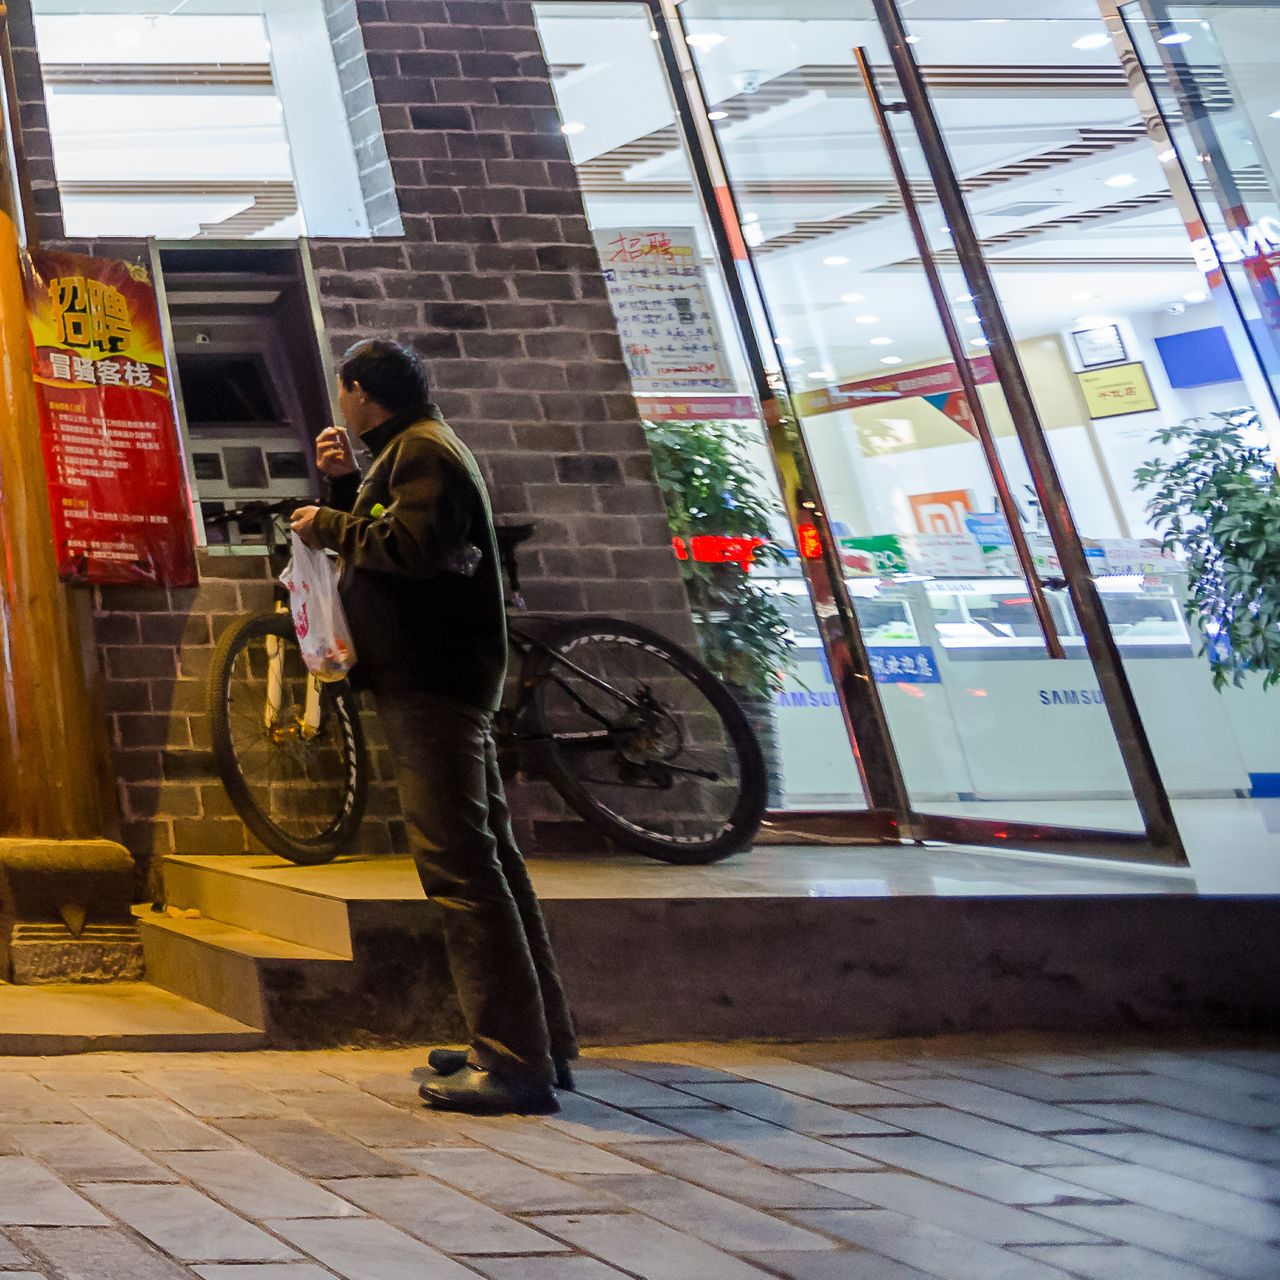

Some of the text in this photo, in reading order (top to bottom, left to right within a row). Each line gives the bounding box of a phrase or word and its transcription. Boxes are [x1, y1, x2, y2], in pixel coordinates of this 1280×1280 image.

[608, 231, 674, 262] 招聘
[48, 276, 132, 352] 招聘
[49, 352, 153, 388] 冒骚客栈
[1038, 689, 1104, 706] SAMSU
